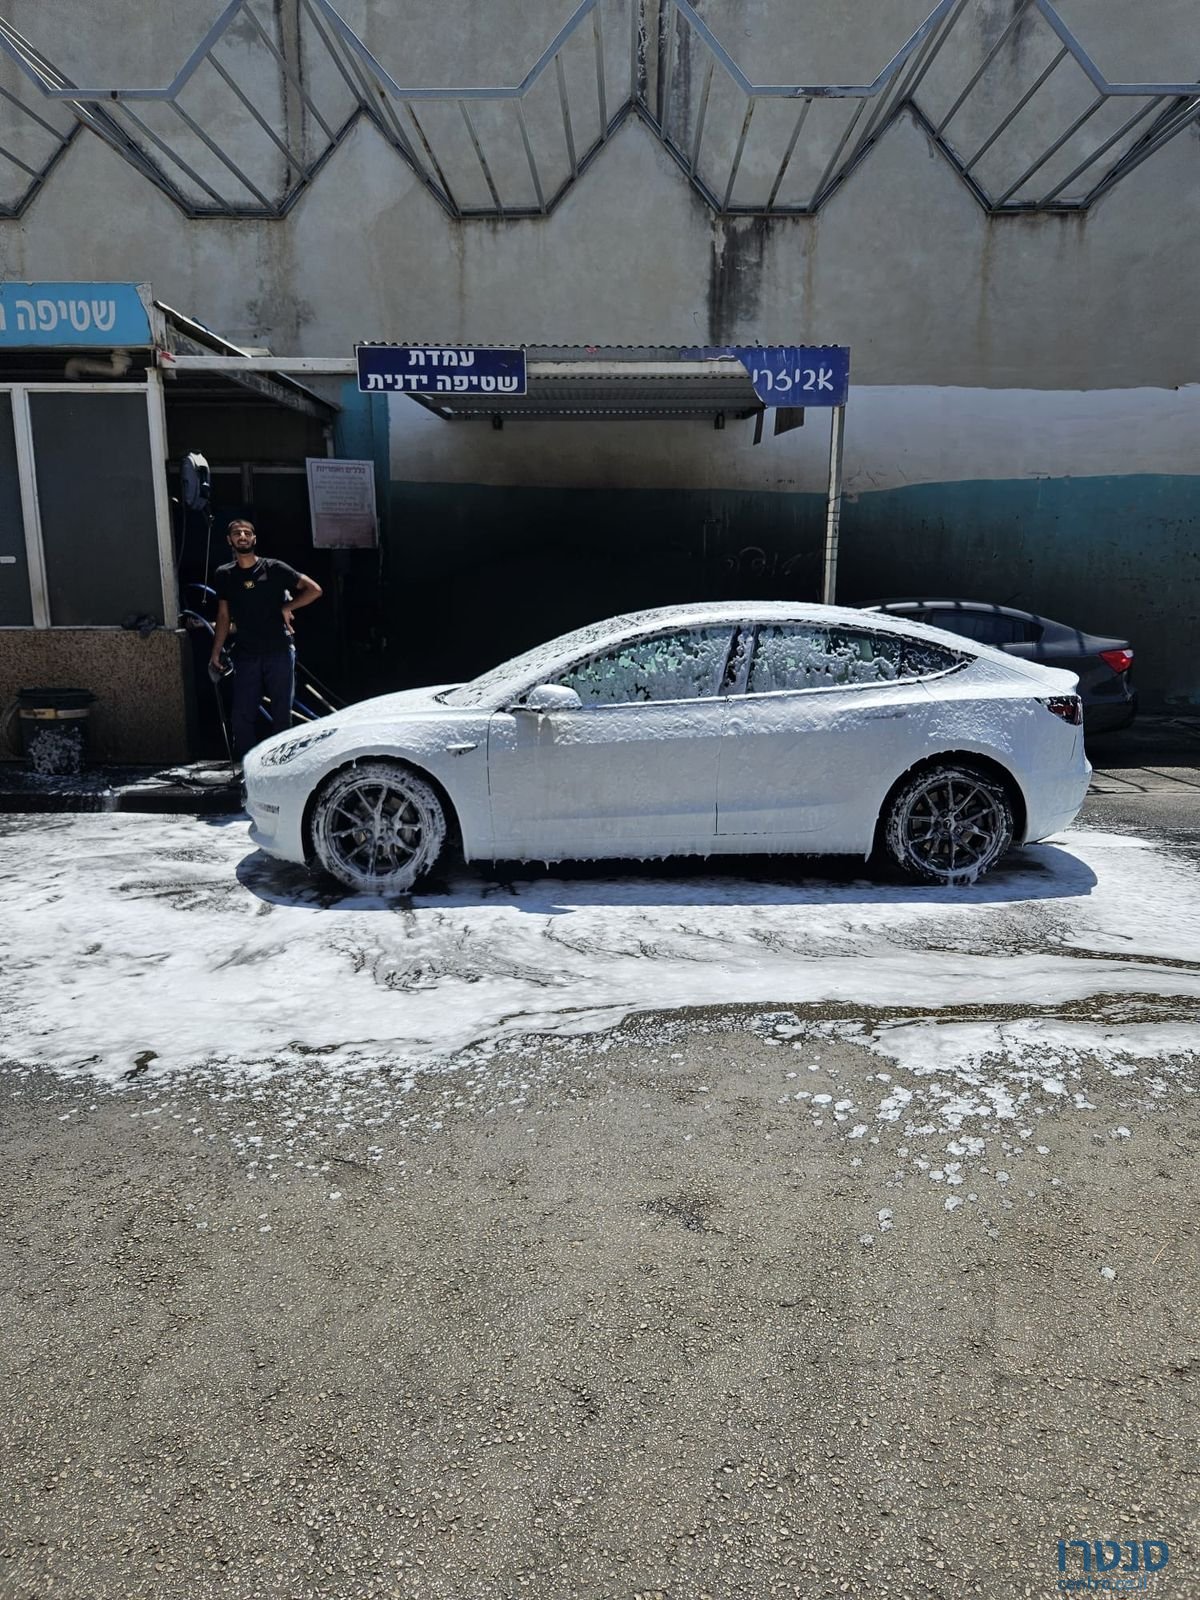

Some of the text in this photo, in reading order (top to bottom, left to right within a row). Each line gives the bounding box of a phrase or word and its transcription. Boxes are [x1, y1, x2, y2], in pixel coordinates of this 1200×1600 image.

[15, 300, 116, 331] שטיפה
[408, 350, 475, 367] עמדת
[367, 373, 519, 392] שטיפה ידנית
[752, 367, 834, 391] אביזרי
